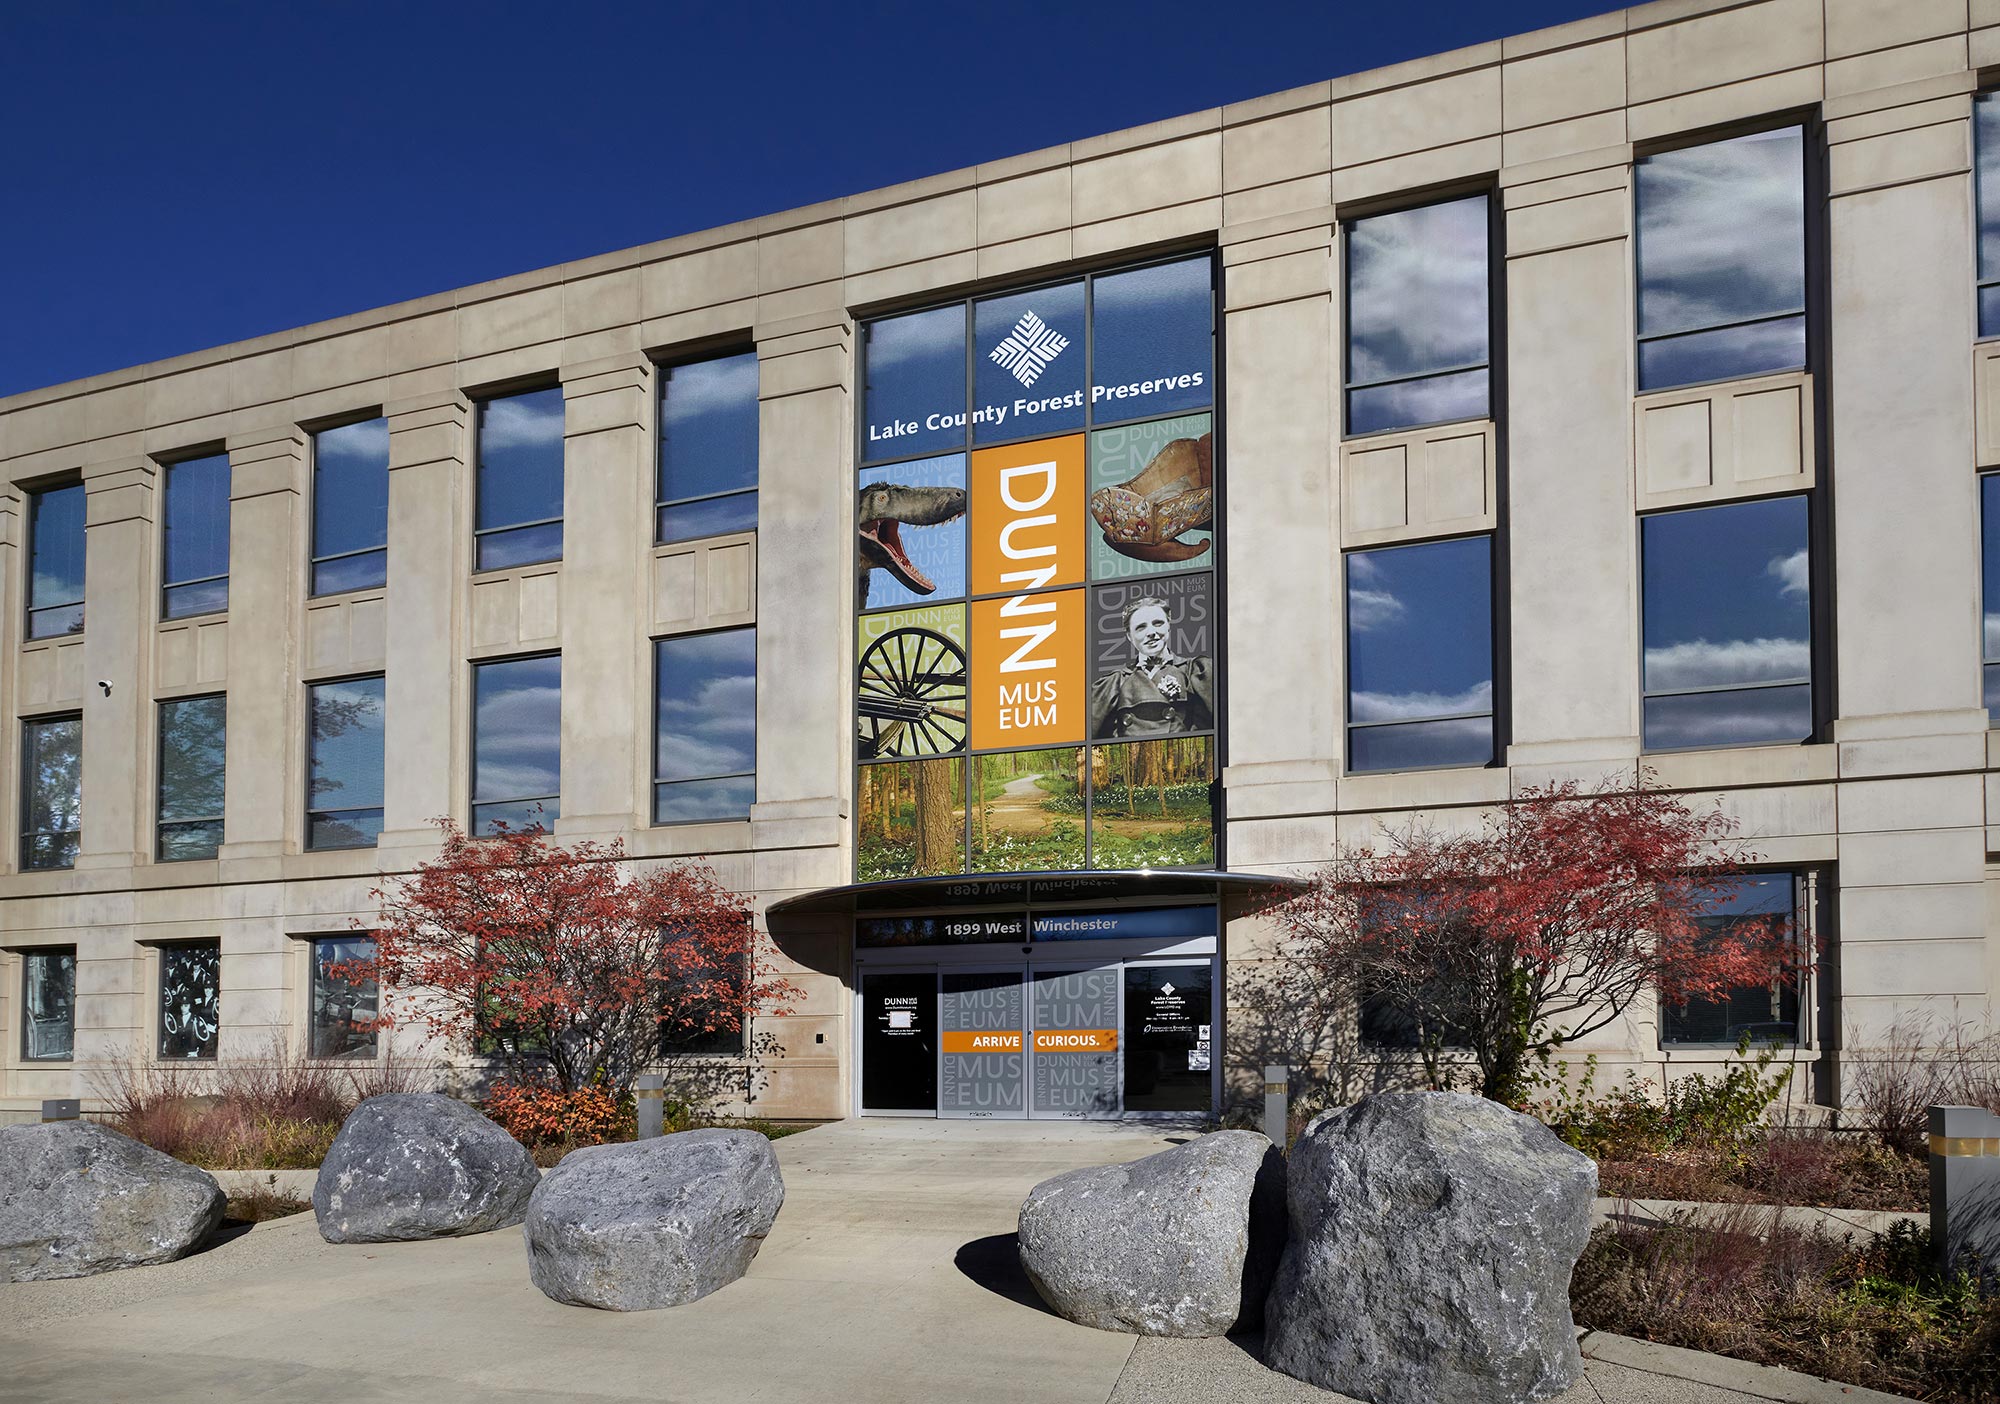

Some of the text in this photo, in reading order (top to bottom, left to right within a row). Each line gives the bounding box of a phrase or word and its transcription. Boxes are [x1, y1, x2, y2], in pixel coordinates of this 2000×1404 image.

[869, 371, 1204, 441] Lake County Forest Preserves
[1130, 421, 1184, 442] DUNN
[893, 459, 942, 479] DUNN
[908, 531, 949, 551] MUS
[1000, 460, 1057, 674] DUNN
[1130, 579, 1184, 600] DUNN
[1186, 577, 1206, 585] MUS
[1186, 584, 1206, 593] EUM
[893, 610, 941, 627] DUNN
[1165, 594, 1207, 624] US
[1097, 586, 1127, 672] DUN
[1000, 680, 1057, 706] MUS
[1000, 704, 1057, 730] EUM
[945, 919, 1118, 936] 1899 West Winchester
[1035, 975, 1101, 1000] MUS
[1103, 975, 1116, 1016] DUNN
[884, 997, 909, 1005] DUNN
[960, 991, 1007, 1009] MUS
[960, 1011, 1007, 1028] EUM
[1035, 1003, 1101, 1027] EUM
[973, 1035, 1100, 1047] ARRIVE CURIOUS.
[958, 1055, 1021, 1079] MUS
[1037, 1055, 1081, 1067] DUNN
[944, 1055, 956, 1095] DUNN
[1037, 1069, 1046, 1098] DUNN
[1050, 1068, 1099, 1086] MUS
[958, 1082, 1021, 1106] EUM
[1050, 1088, 1099, 1106] EUM
